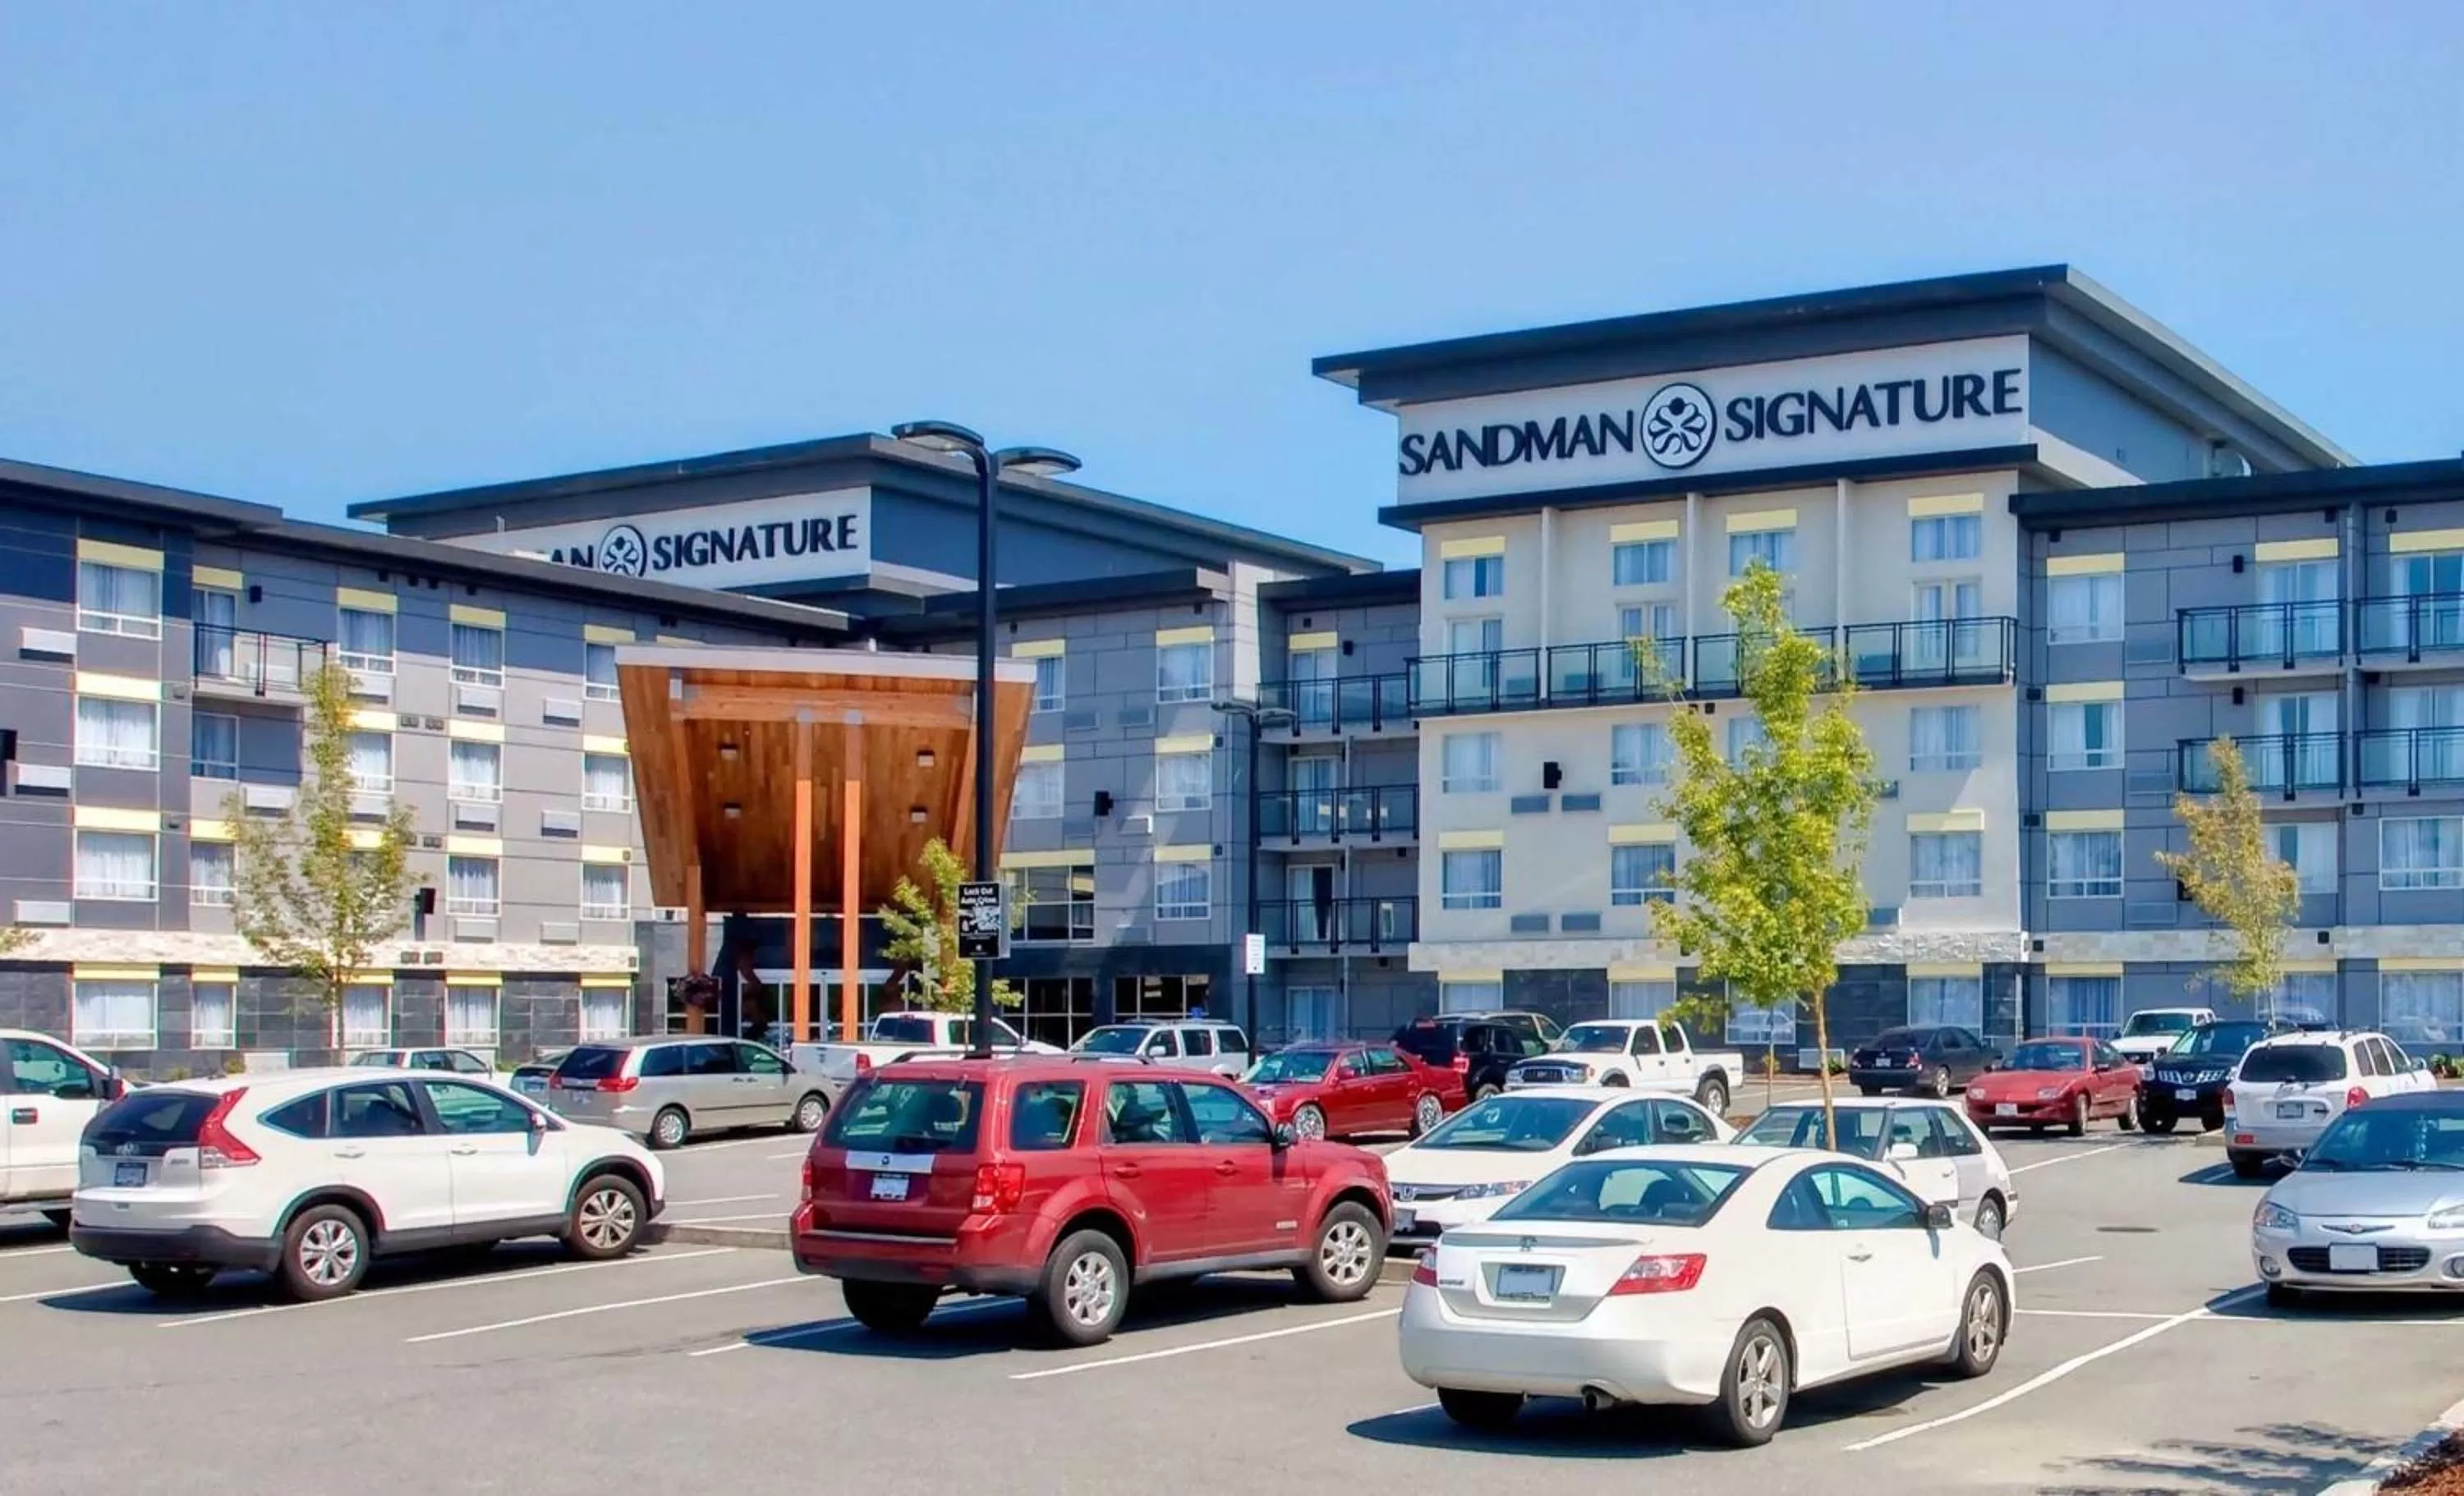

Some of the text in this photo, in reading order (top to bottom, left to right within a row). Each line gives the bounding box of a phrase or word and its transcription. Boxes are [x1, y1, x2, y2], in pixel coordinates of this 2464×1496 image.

[1399, 368, 2023, 476] SANDMAN SIGNATURE
[652, 514, 858, 571] SIGNATURE
